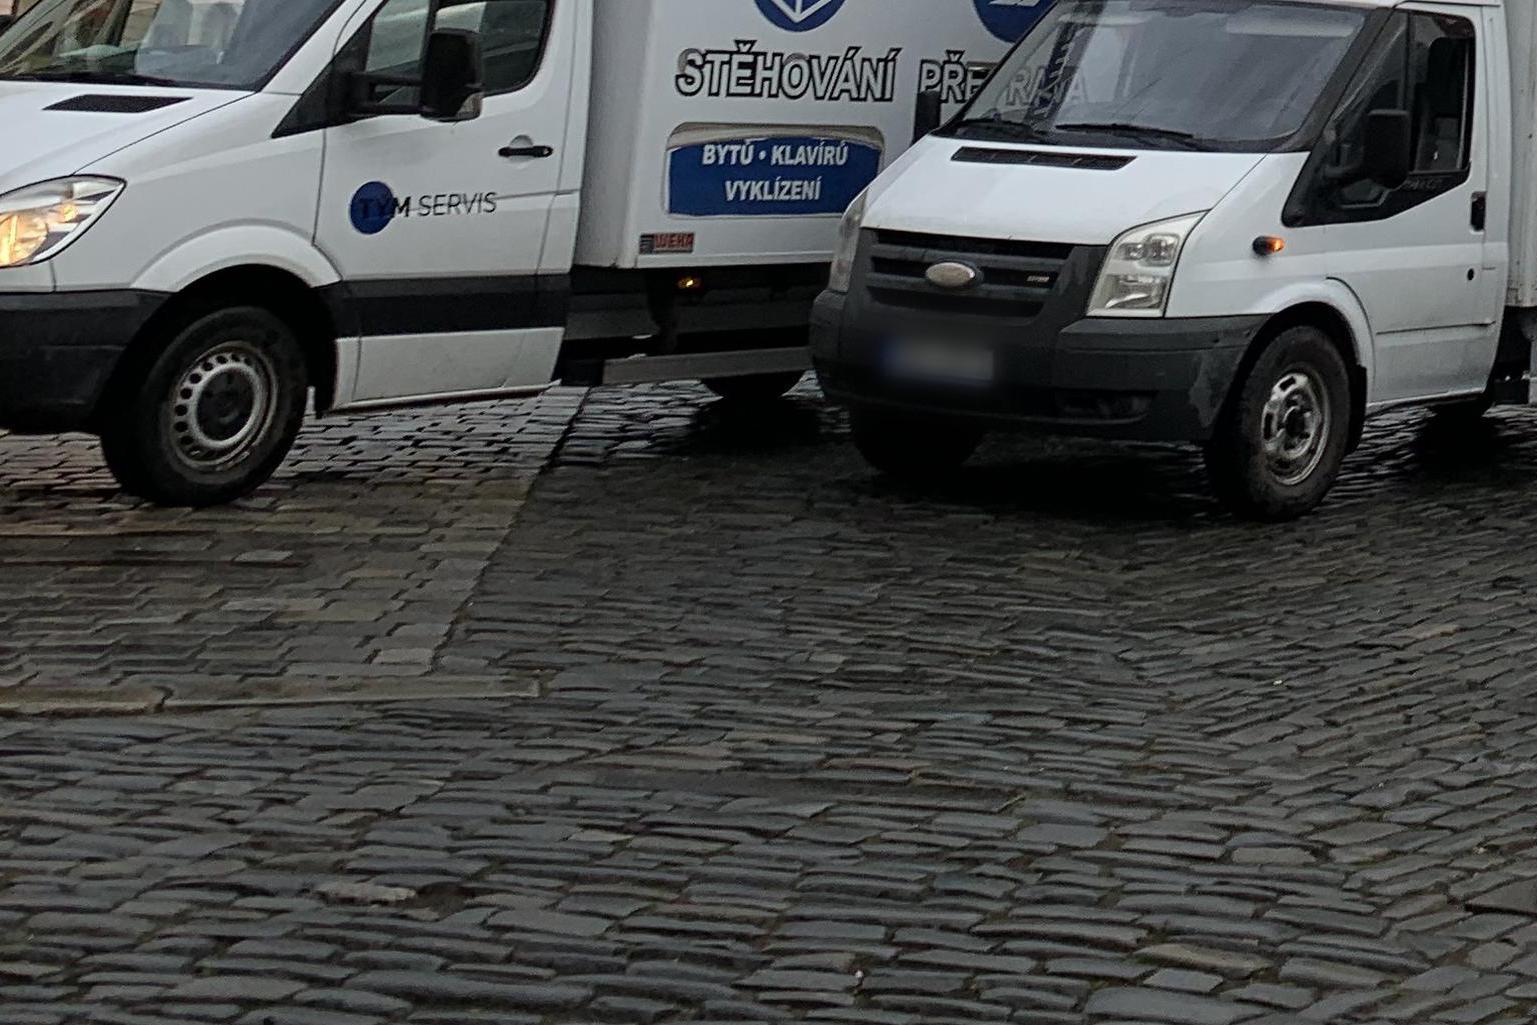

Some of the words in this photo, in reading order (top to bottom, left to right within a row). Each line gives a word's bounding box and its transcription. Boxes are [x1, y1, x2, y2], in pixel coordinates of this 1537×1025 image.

[675, 39, 901, 103] STĚHOVÁNÍ
[725, 176, 822, 201] VYKLÍZENÍ
[418, 192, 497, 217] SERVIS
